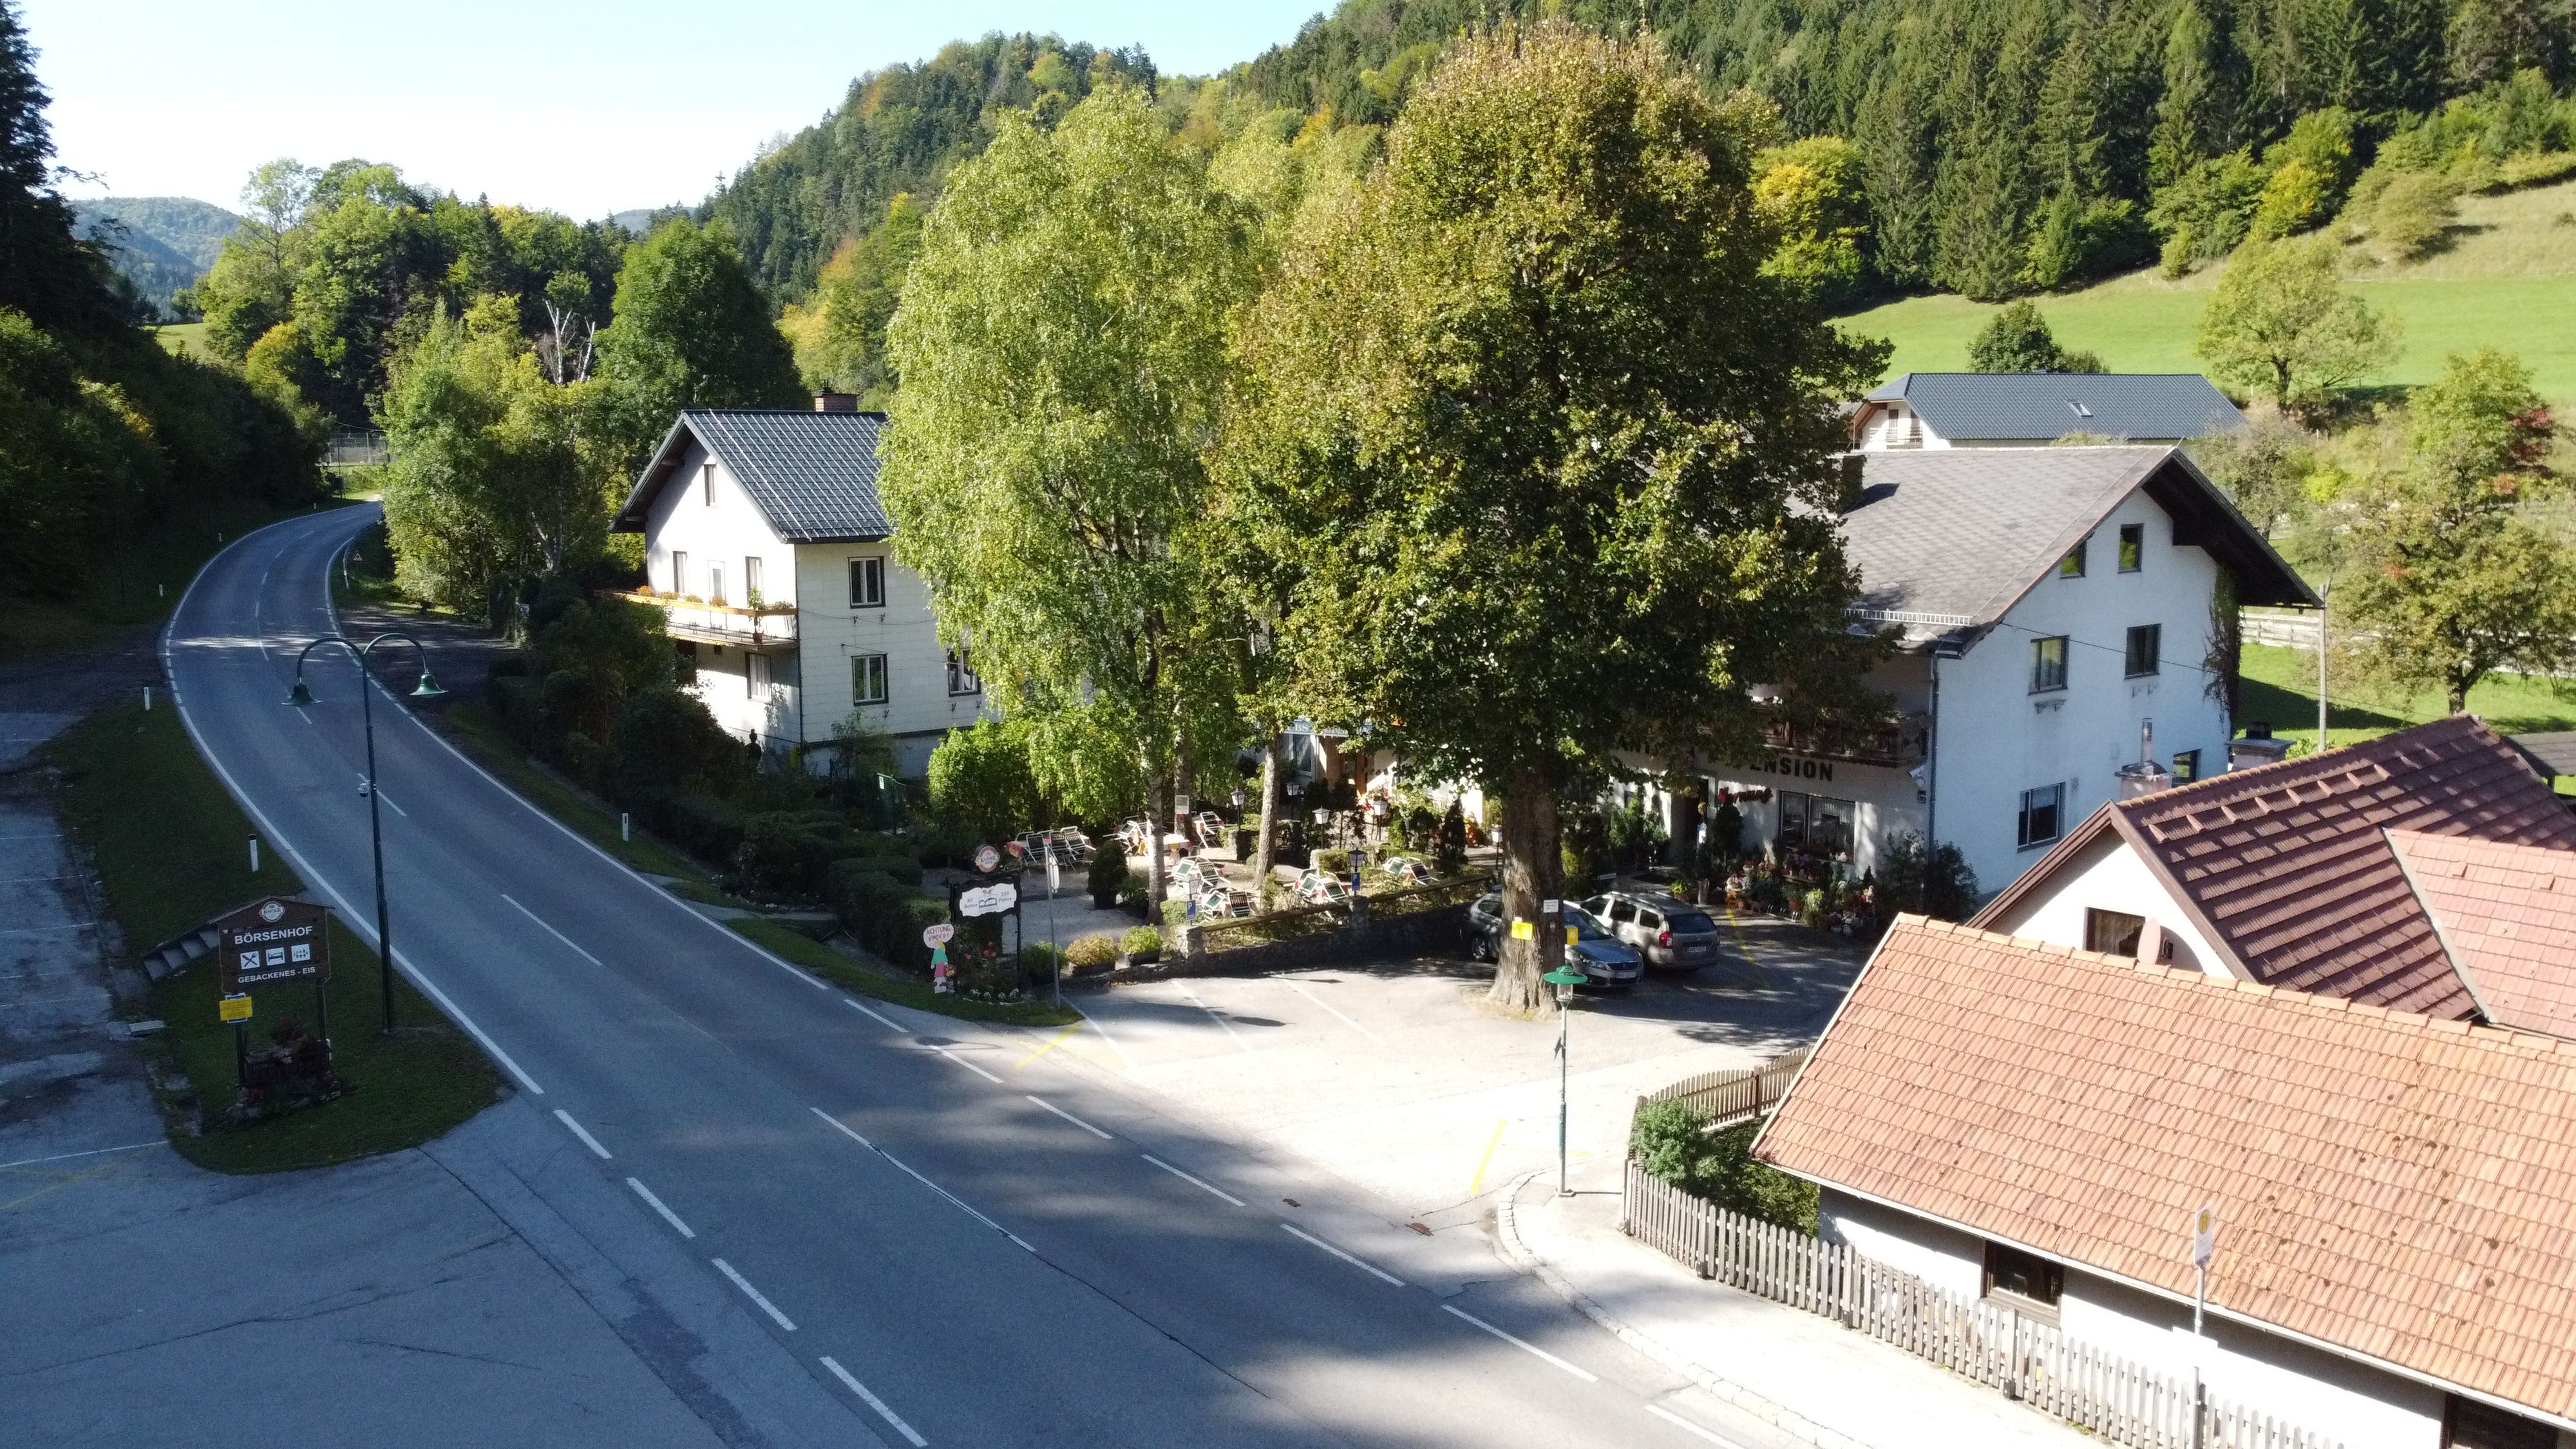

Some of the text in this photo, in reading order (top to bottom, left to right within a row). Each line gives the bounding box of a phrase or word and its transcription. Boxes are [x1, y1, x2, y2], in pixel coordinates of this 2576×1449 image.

[1750, 757, 1833, 781] NSION
[234, 926, 313, 945] BÖRSENHOF
[926, 925, 951, 935] ACHTUNG
[238, 970, 296, 983] GEBACKENES
